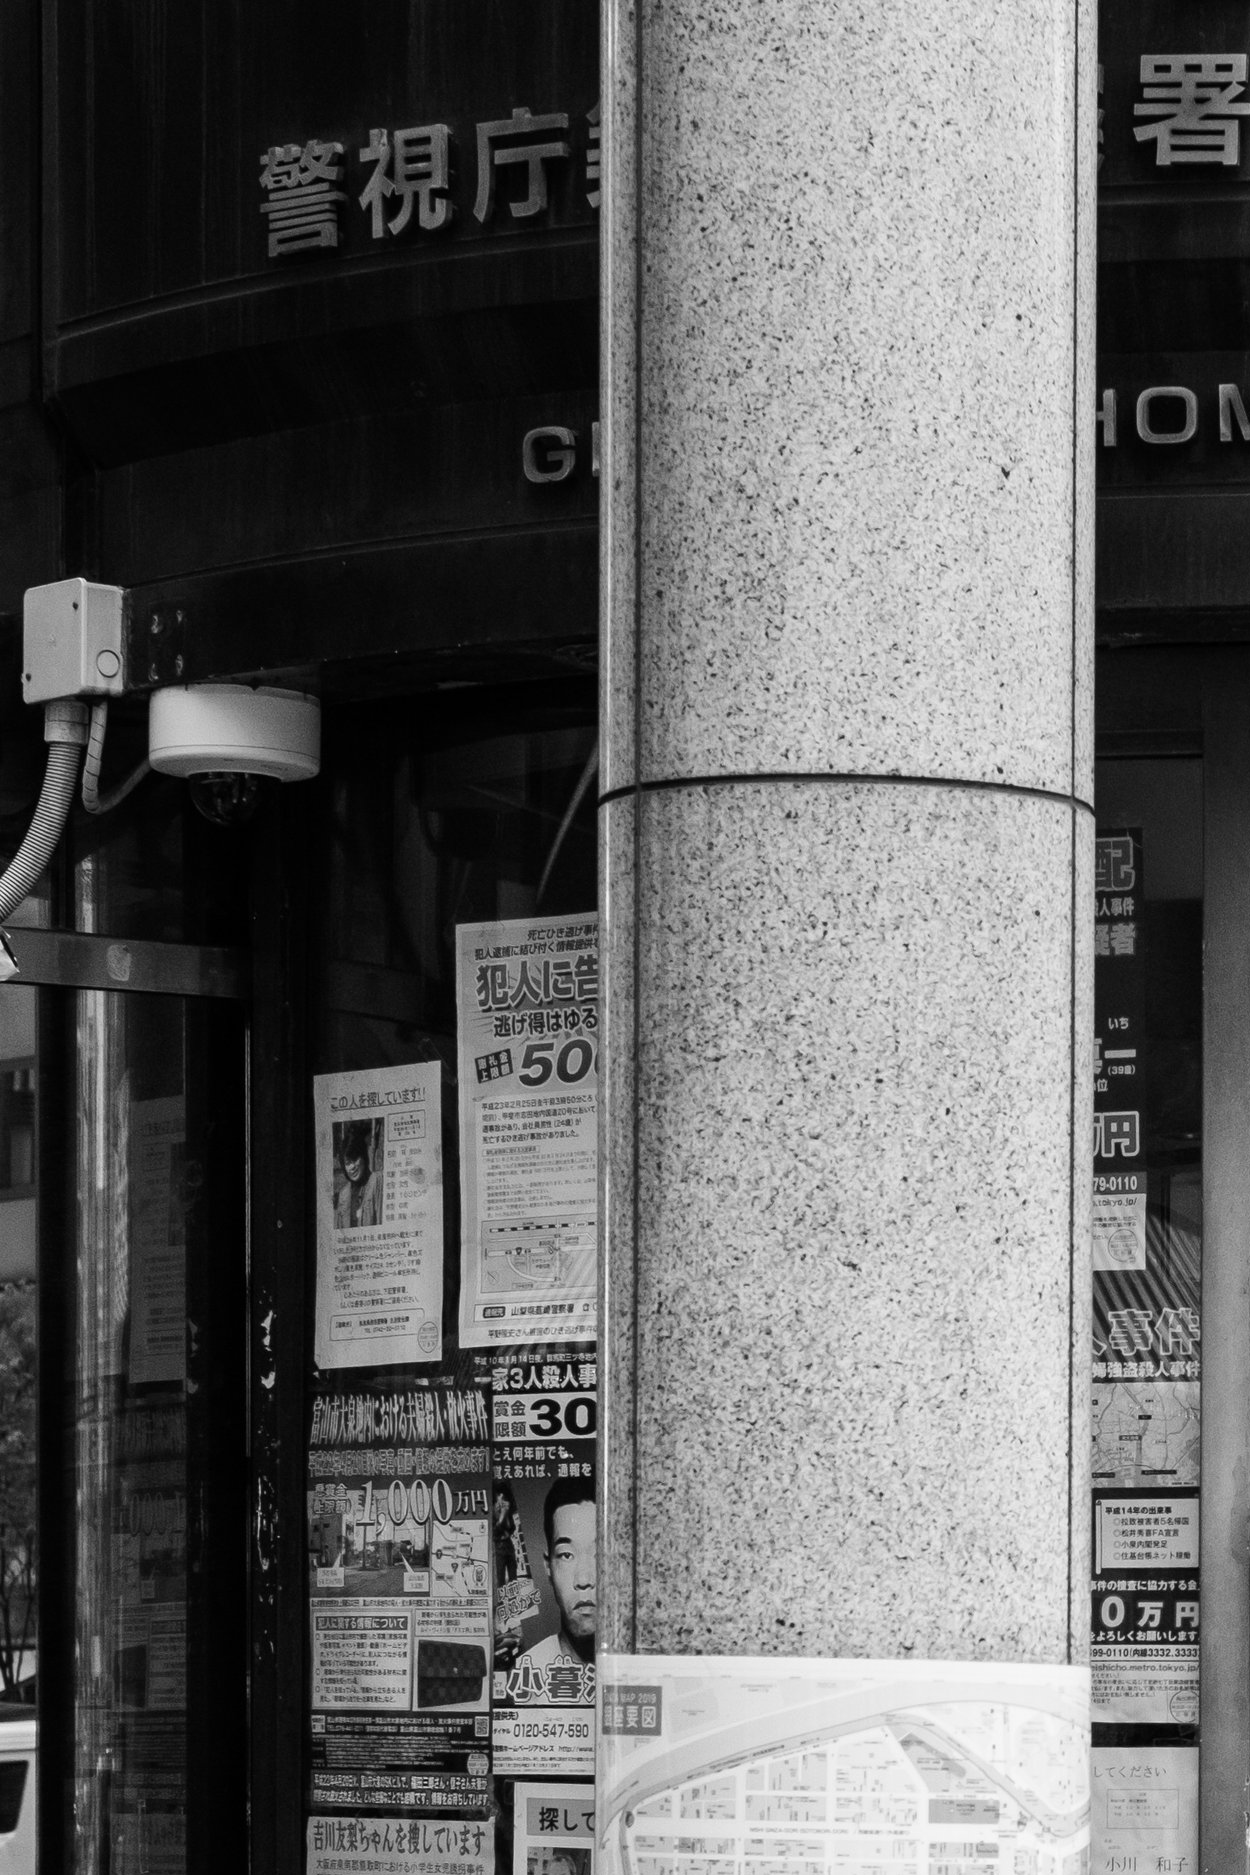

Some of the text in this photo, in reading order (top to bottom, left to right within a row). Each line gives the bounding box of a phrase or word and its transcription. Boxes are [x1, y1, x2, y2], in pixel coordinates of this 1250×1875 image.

[1108, 1016, 1130, 1030] いち
[519, 1036, 598, 1088] 50
[1093, 1110, 1141, 1158] 円
[1093, 1307, 1201, 1357] 事件
[558, 1463, 593, 1479] 通報を
[356, 1479, 490, 1537] 1,000万円
[1105, 1506, 1173, 1516] 平成14年の出来事
[1121, 1528, 1180, 1538] 松井秀喜FA宣言
[1101, 1595, 1200, 1628] 0万円
[514, 1723, 590, 1739] 0120-547-590
[1093, 1766, 1167, 1779] してください
[313, 1820, 486, 1856] 吉川友梨ちゃんを捜しています
[1105, 1856, 1190, 1874] 小川 和子
